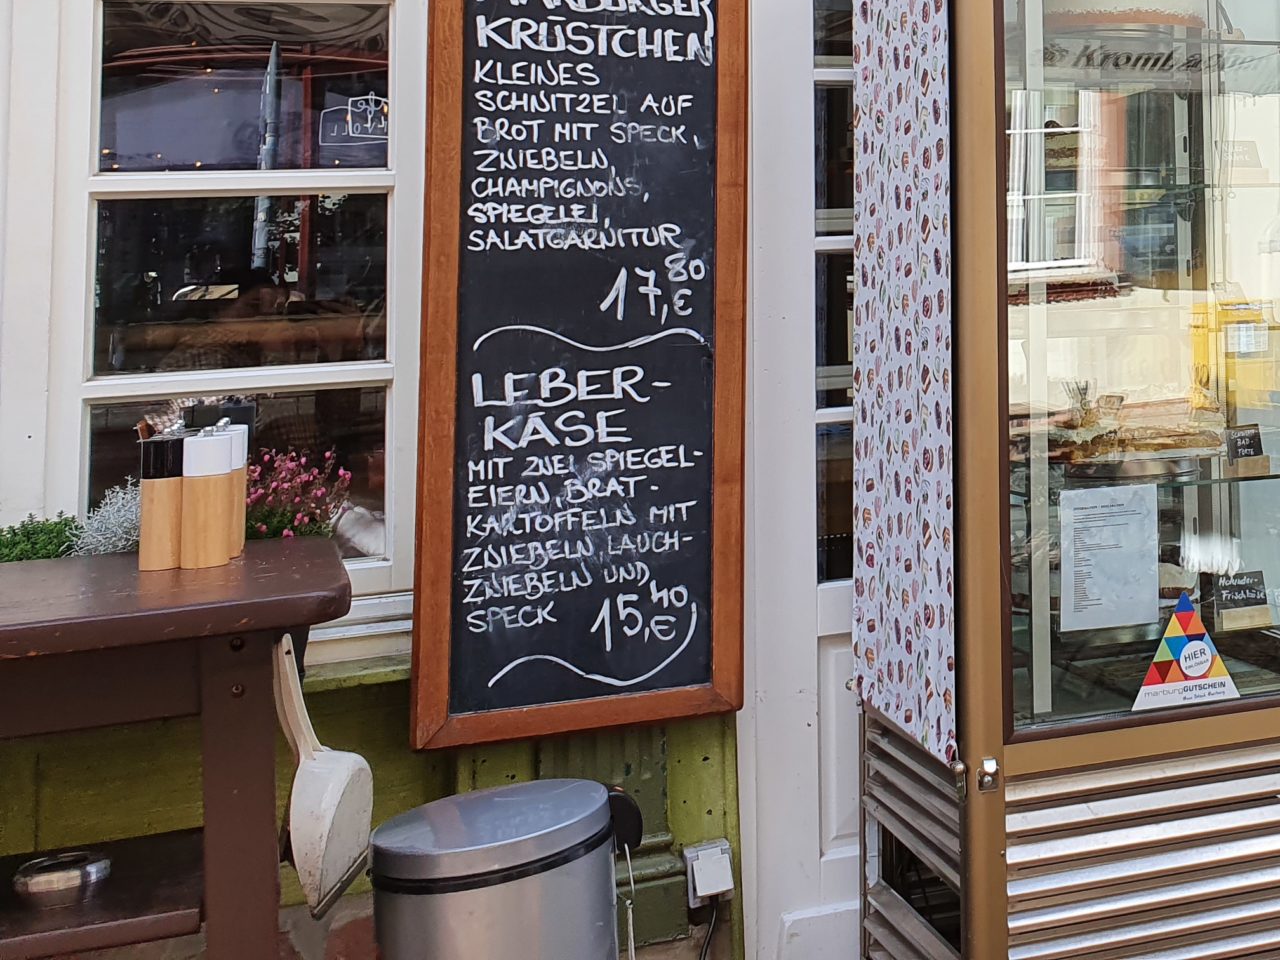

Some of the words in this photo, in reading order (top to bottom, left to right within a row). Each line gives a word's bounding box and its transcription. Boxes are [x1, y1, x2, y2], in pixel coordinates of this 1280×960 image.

[475, 15, 713, 66] KRÜSTCHEN
[474, 59, 600, 86] KLEINES
[475, 91, 627, 114] SCHNITZEL
[640, 95, 694, 116] AUF
[473, 118, 545, 143] BROT
[554, 123, 599, 142] MIT
[467, 223, 682, 252] SALATGARNITUR
[471, 366, 672, 407] LEBER-
[483, 408, 632, 451] KÄSE
[467, 457, 512, 482] MIT
[521, 453, 575, 477] ZWEI
[587, 444, 703, 472] SPIEGEL-
[466, 504, 637, 538] KARTOFFELN
[649, 500, 697, 524] MIT
[462, 562, 593, 604] ZWIEBELN
[604, 560, 651, 587] UND
[466, 600, 558, 633] SPECK
[1184, 647, 1207, 662] HIER
